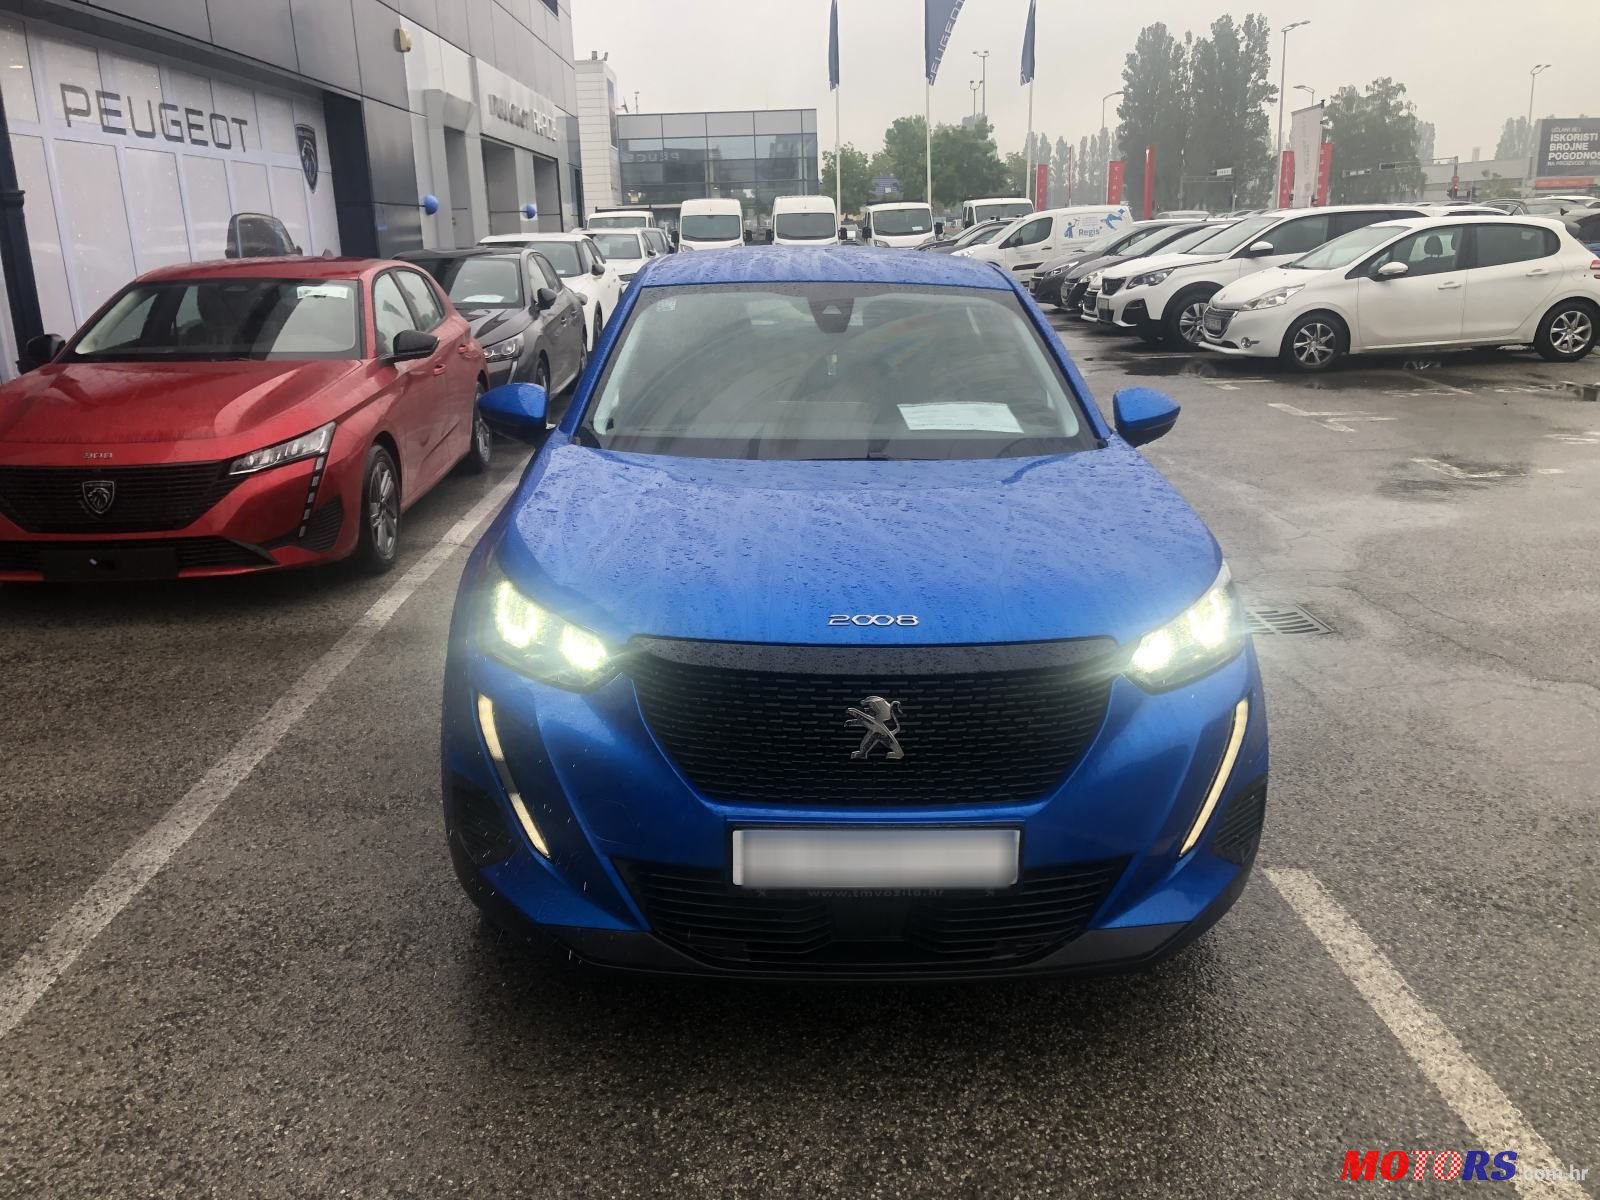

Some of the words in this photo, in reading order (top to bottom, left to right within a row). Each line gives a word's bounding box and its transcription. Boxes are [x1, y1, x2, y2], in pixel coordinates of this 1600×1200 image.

[60, 83, 248, 152] PEUGEOT
[1550, 133, 1599, 142] ISKORISTI
[1549, 143, 1589, 152] BROJNE
[1078, 228, 1100, 238] Regis
[827, 614, 919, 626] 2008
